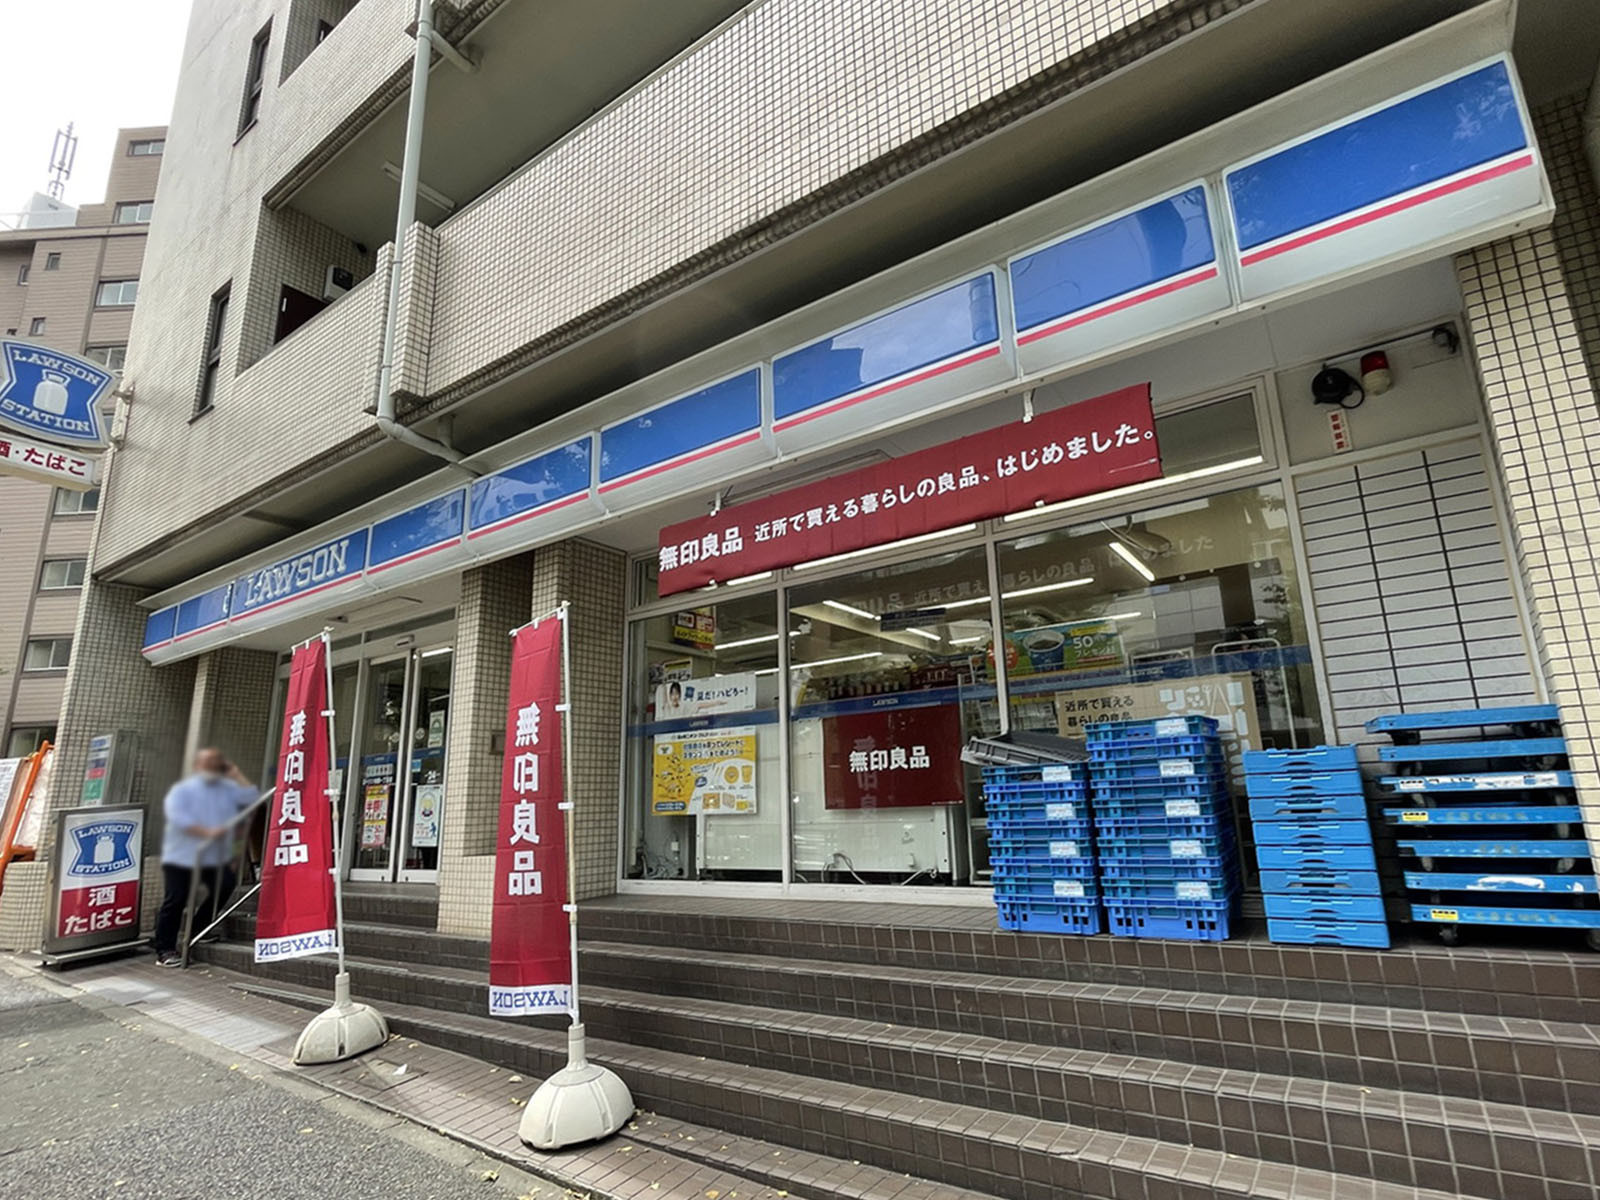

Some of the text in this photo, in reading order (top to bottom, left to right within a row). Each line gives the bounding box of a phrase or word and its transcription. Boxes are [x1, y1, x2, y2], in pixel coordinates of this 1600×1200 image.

[13, 350, 100, 386] LAWSON
[1, 400, 90, 432] STATION
[659, 526, 743, 572] 無印良品
[245, 540, 349, 607] LAWSON
[1065, 696, 1134, 713] 近所で買える
[849, 745, 931, 773] 無印良品
[78, 824, 132, 838] LAWSON
[74, 858, 130, 873] STATION
[88, 885, 117, 907] 酒
[64, 906, 132, 935] たばこ
